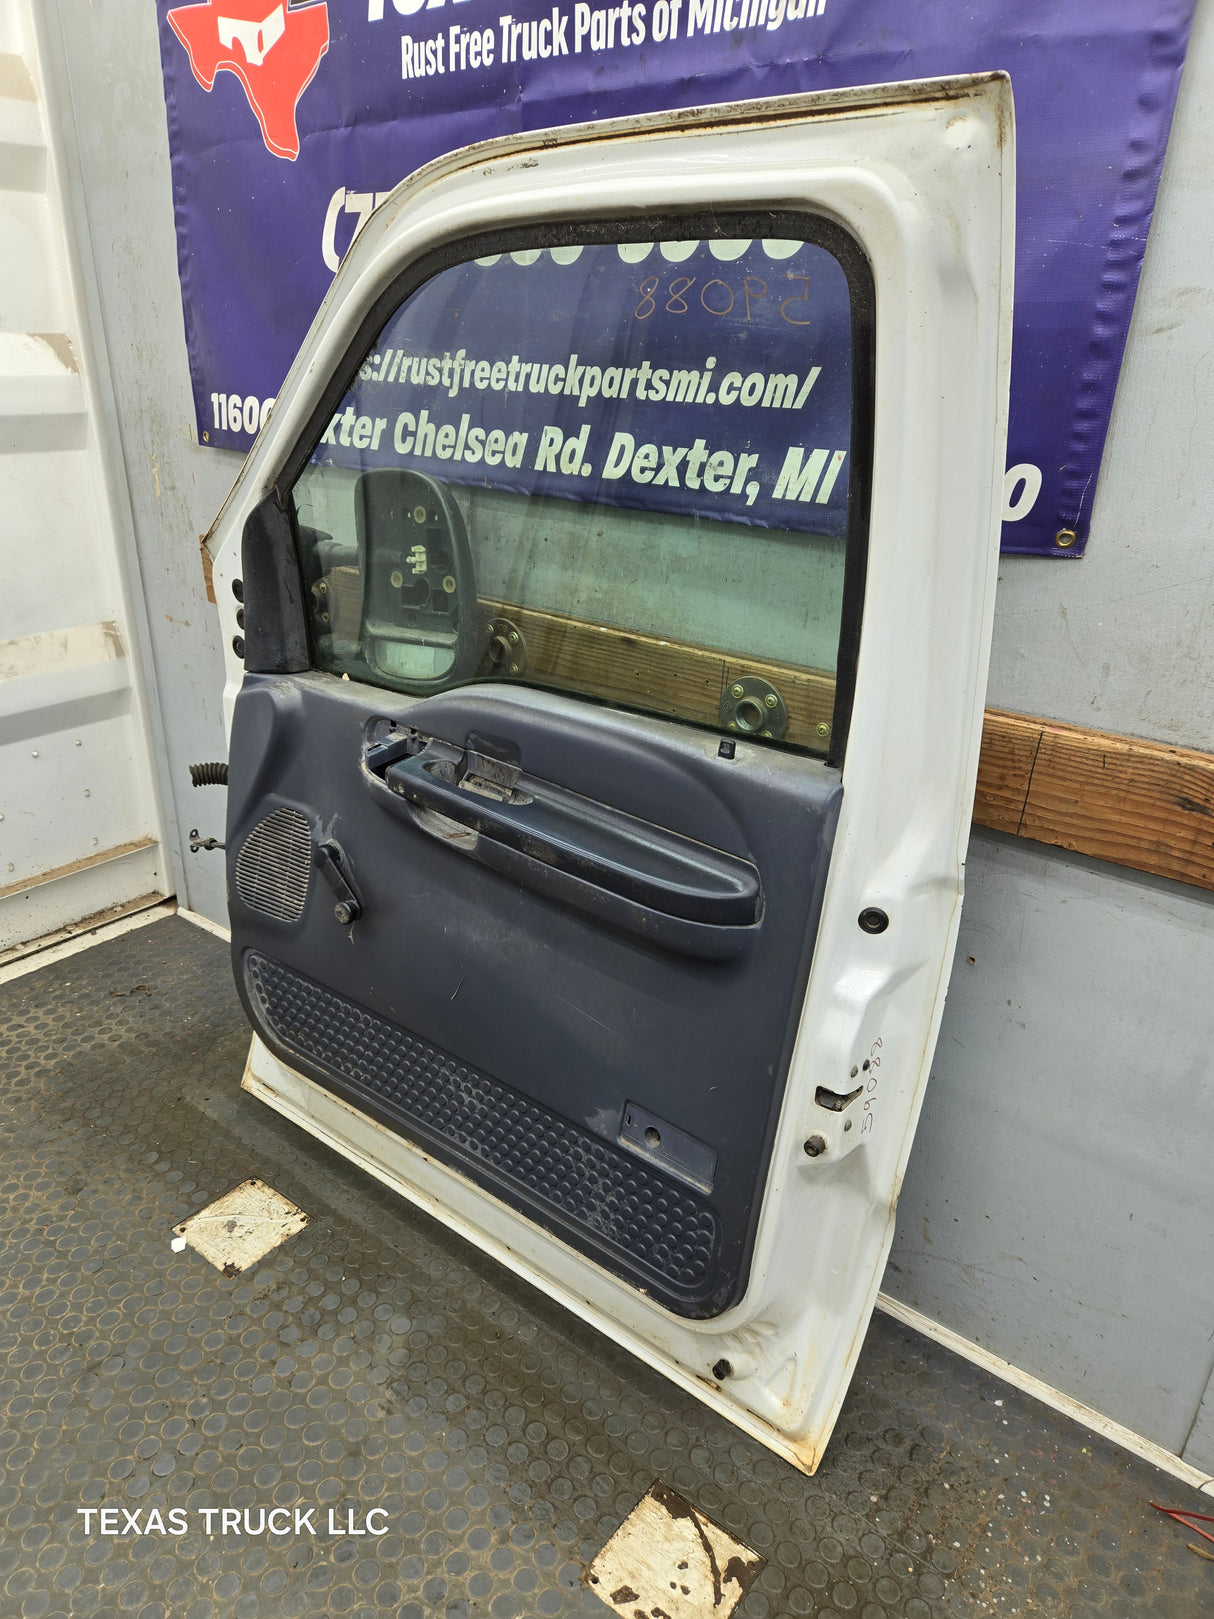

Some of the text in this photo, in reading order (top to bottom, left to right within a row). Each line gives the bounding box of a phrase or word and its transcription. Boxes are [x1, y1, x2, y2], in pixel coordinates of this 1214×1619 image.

[400, 33, 446, 80] Rust
[449, 25, 495, 72] Free
[500, 7, 569, 63] Truck
[574, 0, 647, 54] Parts
[651, 0, 683, 42] of
[358, 348, 823, 409] s://rustfreetruckpartsmi.com/
[319, 406, 388, 451] xter
[393, 409, 529, 469] Chelsea
[533, 424, 593, 477] Rd.
[601, 431, 760, 506] Dexter,
[771, 446, 848, 505] MI
